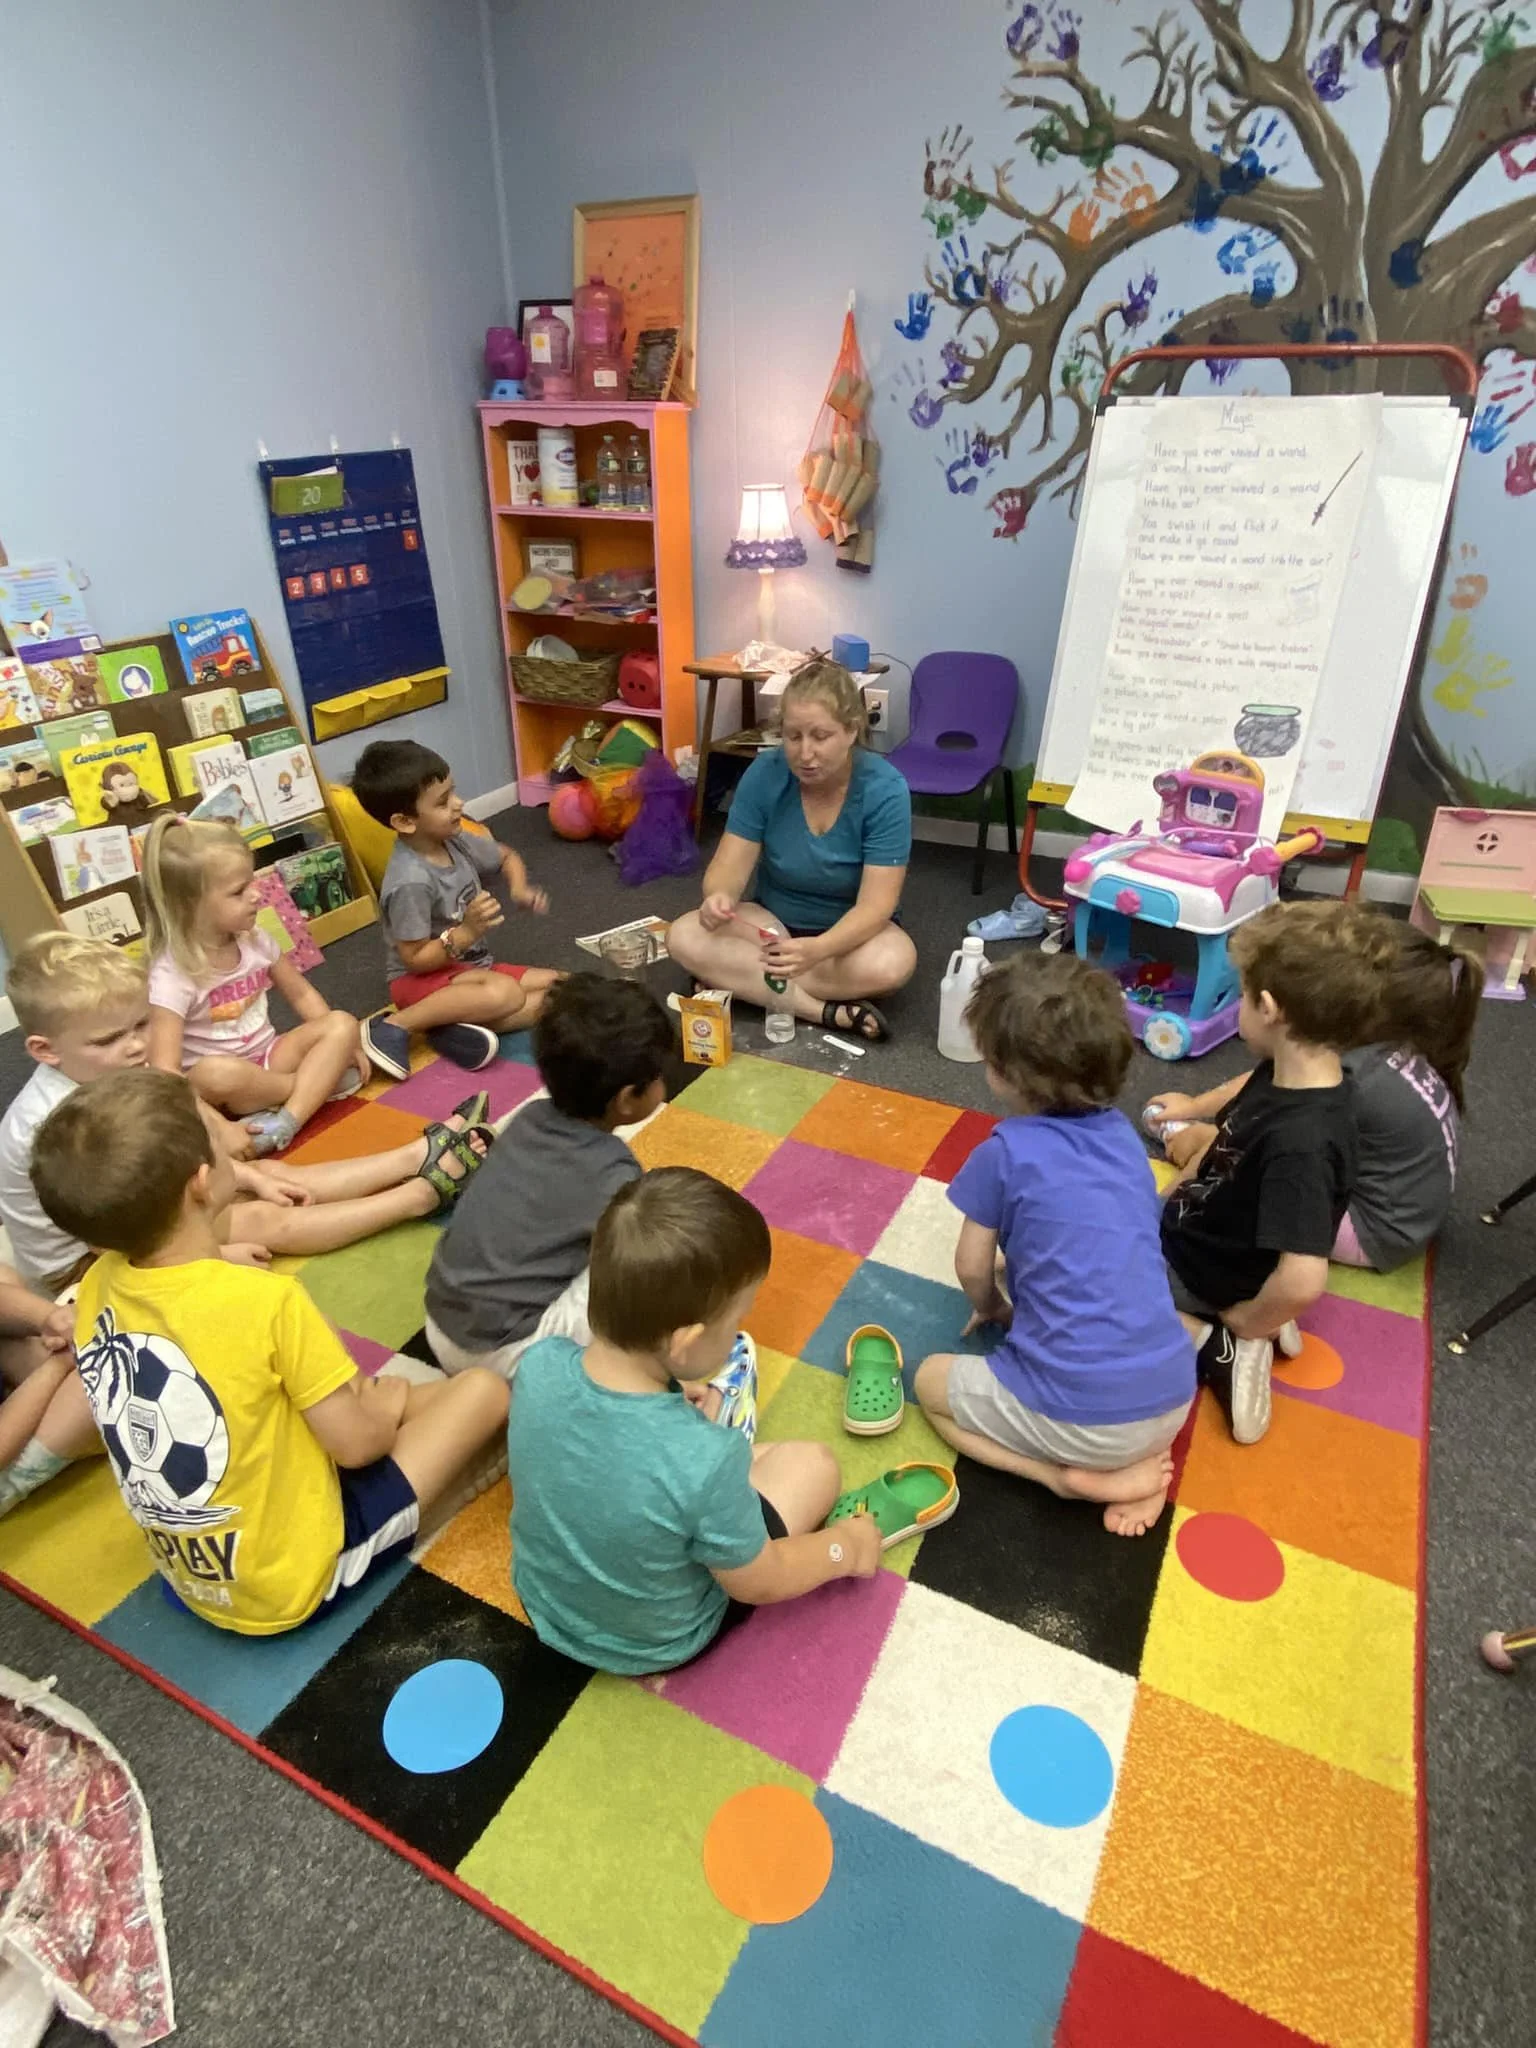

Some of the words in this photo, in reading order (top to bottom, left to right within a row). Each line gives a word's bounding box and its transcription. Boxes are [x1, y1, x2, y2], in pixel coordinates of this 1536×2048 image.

[1154, 441, 1177, 457] Have
[1145, 479, 1169, 493] Have
[302, 486, 321, 506] 20
